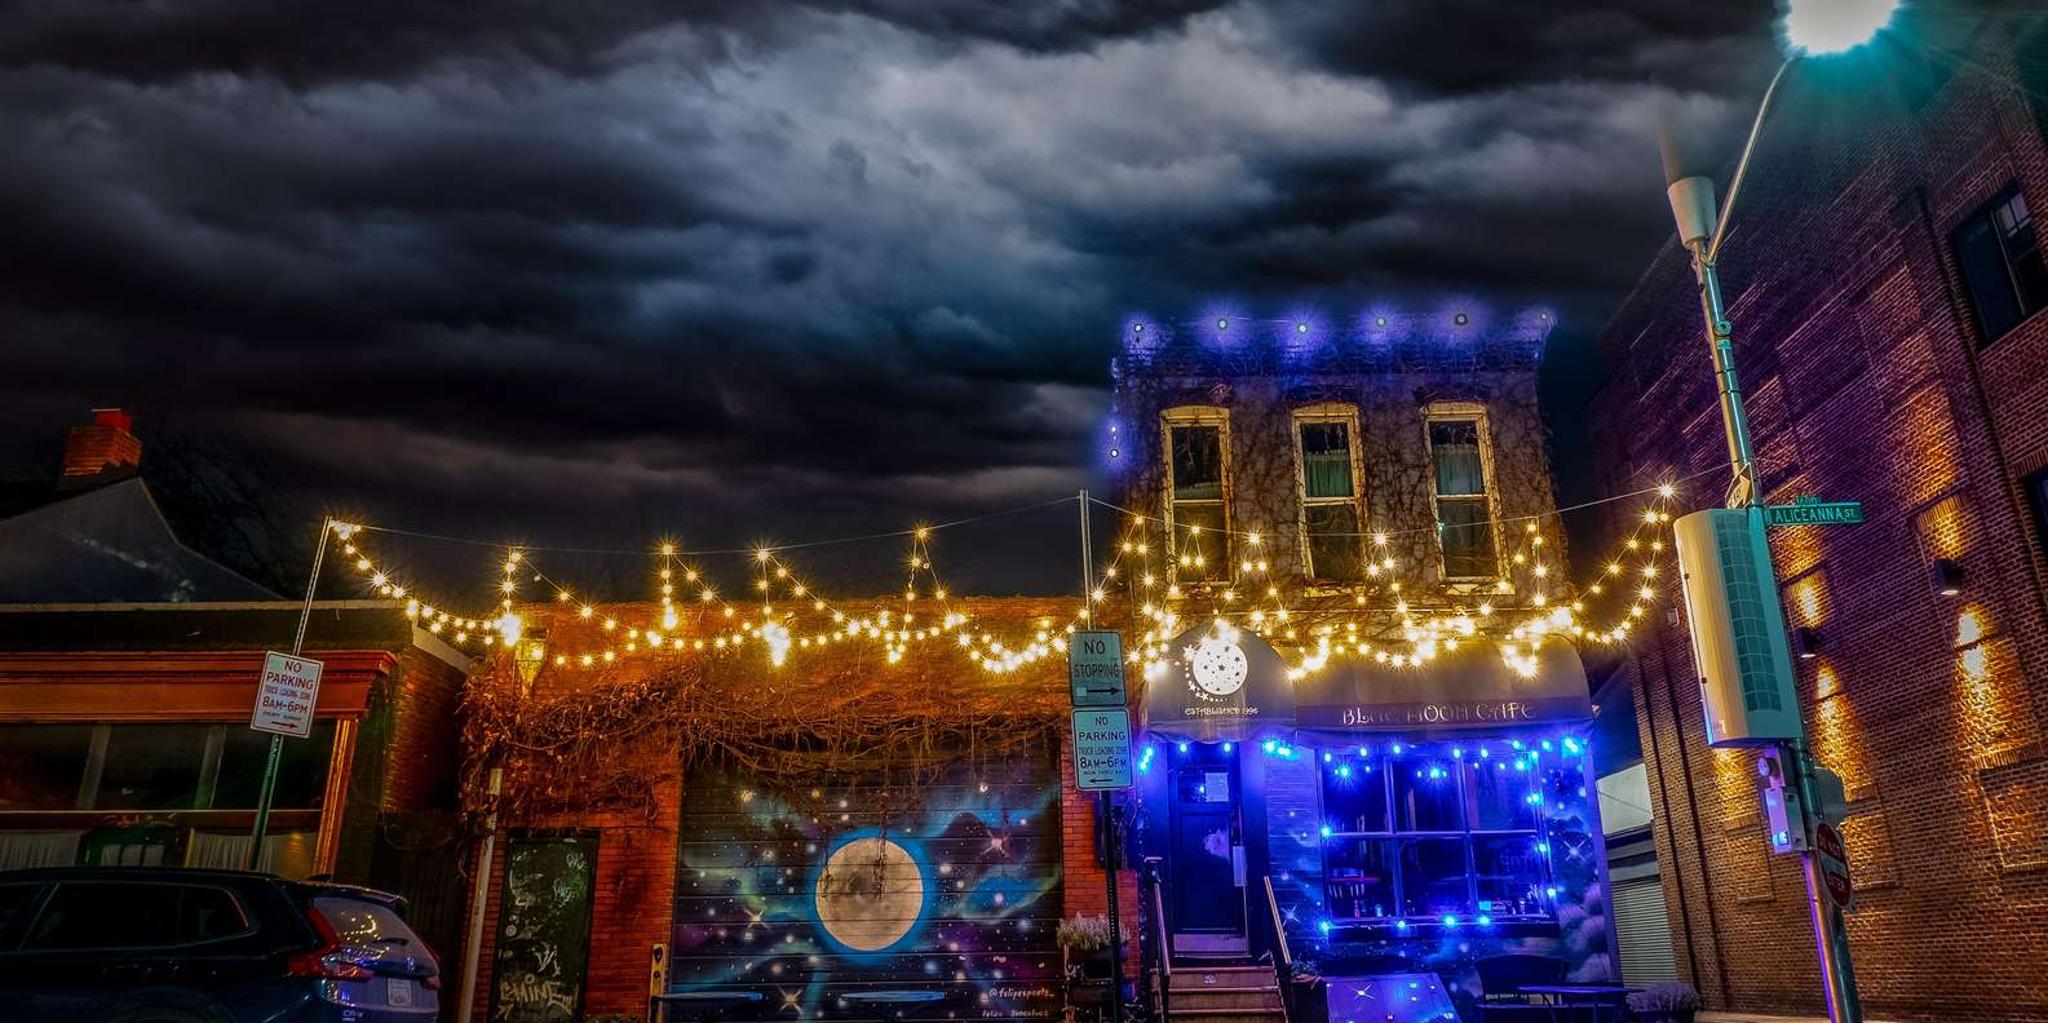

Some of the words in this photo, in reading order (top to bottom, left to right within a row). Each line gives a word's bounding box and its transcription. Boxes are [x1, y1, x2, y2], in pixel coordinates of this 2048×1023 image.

[1775, 507, 1843, 523] ALICEANNA
[1083, 640, 1106, 655] NO
[283, 661, 302, 673] NO
[1074, 661, 1120, 678] STOPPING
[266, 671, 314, 690] PARKING
[261, 695, 309, 714] 8AM-6PM
[1407, 703, 1470, 724] MOON
[1475, 701, 1538, 722] CAFE
[1095, 716, 1109, 726] NO
[1079, 731, 1126, 741] PARKING
[1080, 756, 1127, 769] 8AM-6PM
